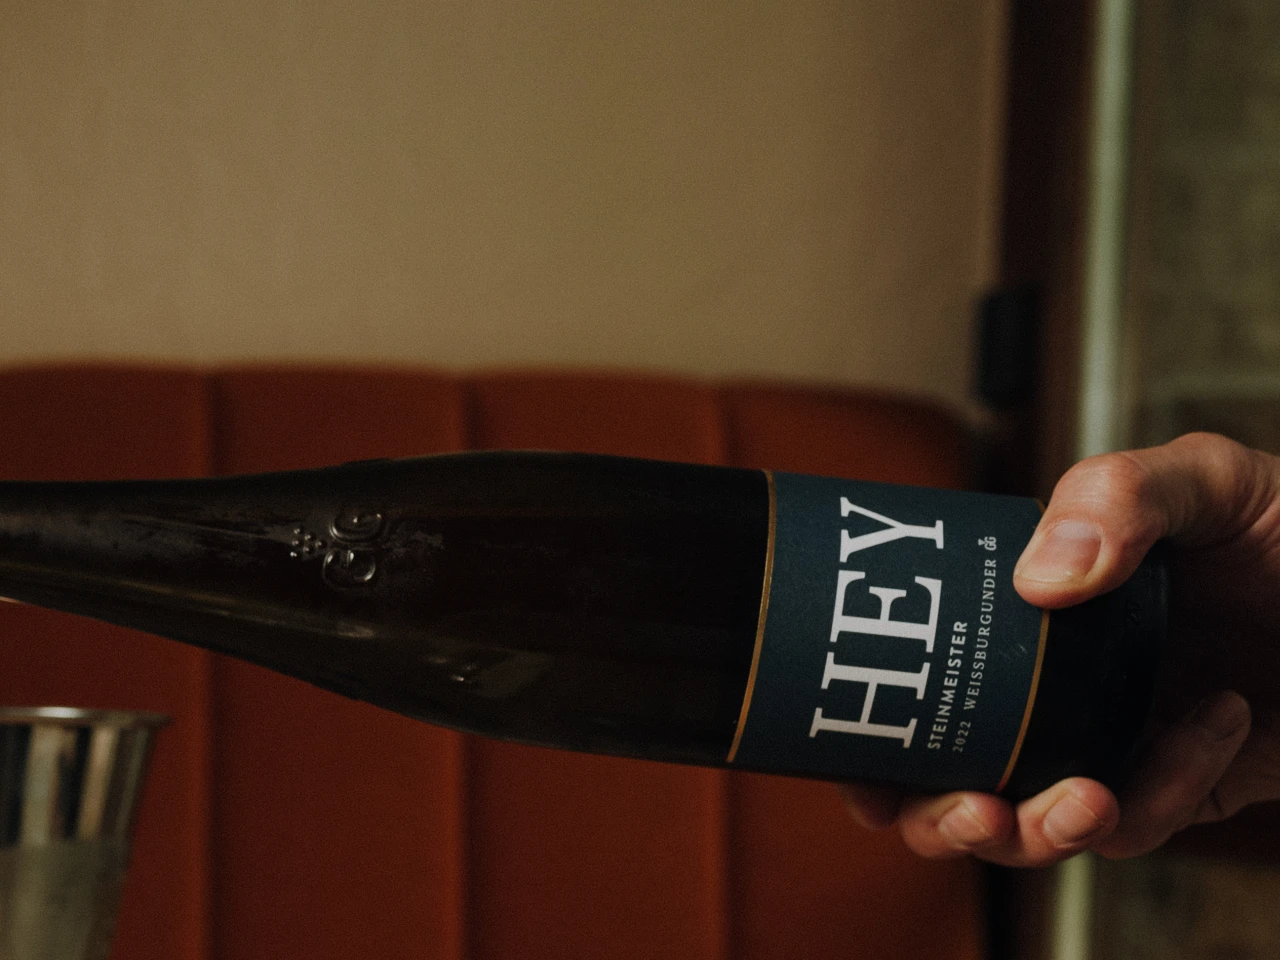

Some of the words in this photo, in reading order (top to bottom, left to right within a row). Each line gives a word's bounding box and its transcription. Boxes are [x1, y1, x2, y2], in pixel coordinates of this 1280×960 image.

[809, 496, 945, 749] HEY
[927, 620, 968, 749] STEINMEISTER
[952, 720, 971, 752] 2022
[963, 558, 997, 710] WEISSBURGUNDER
